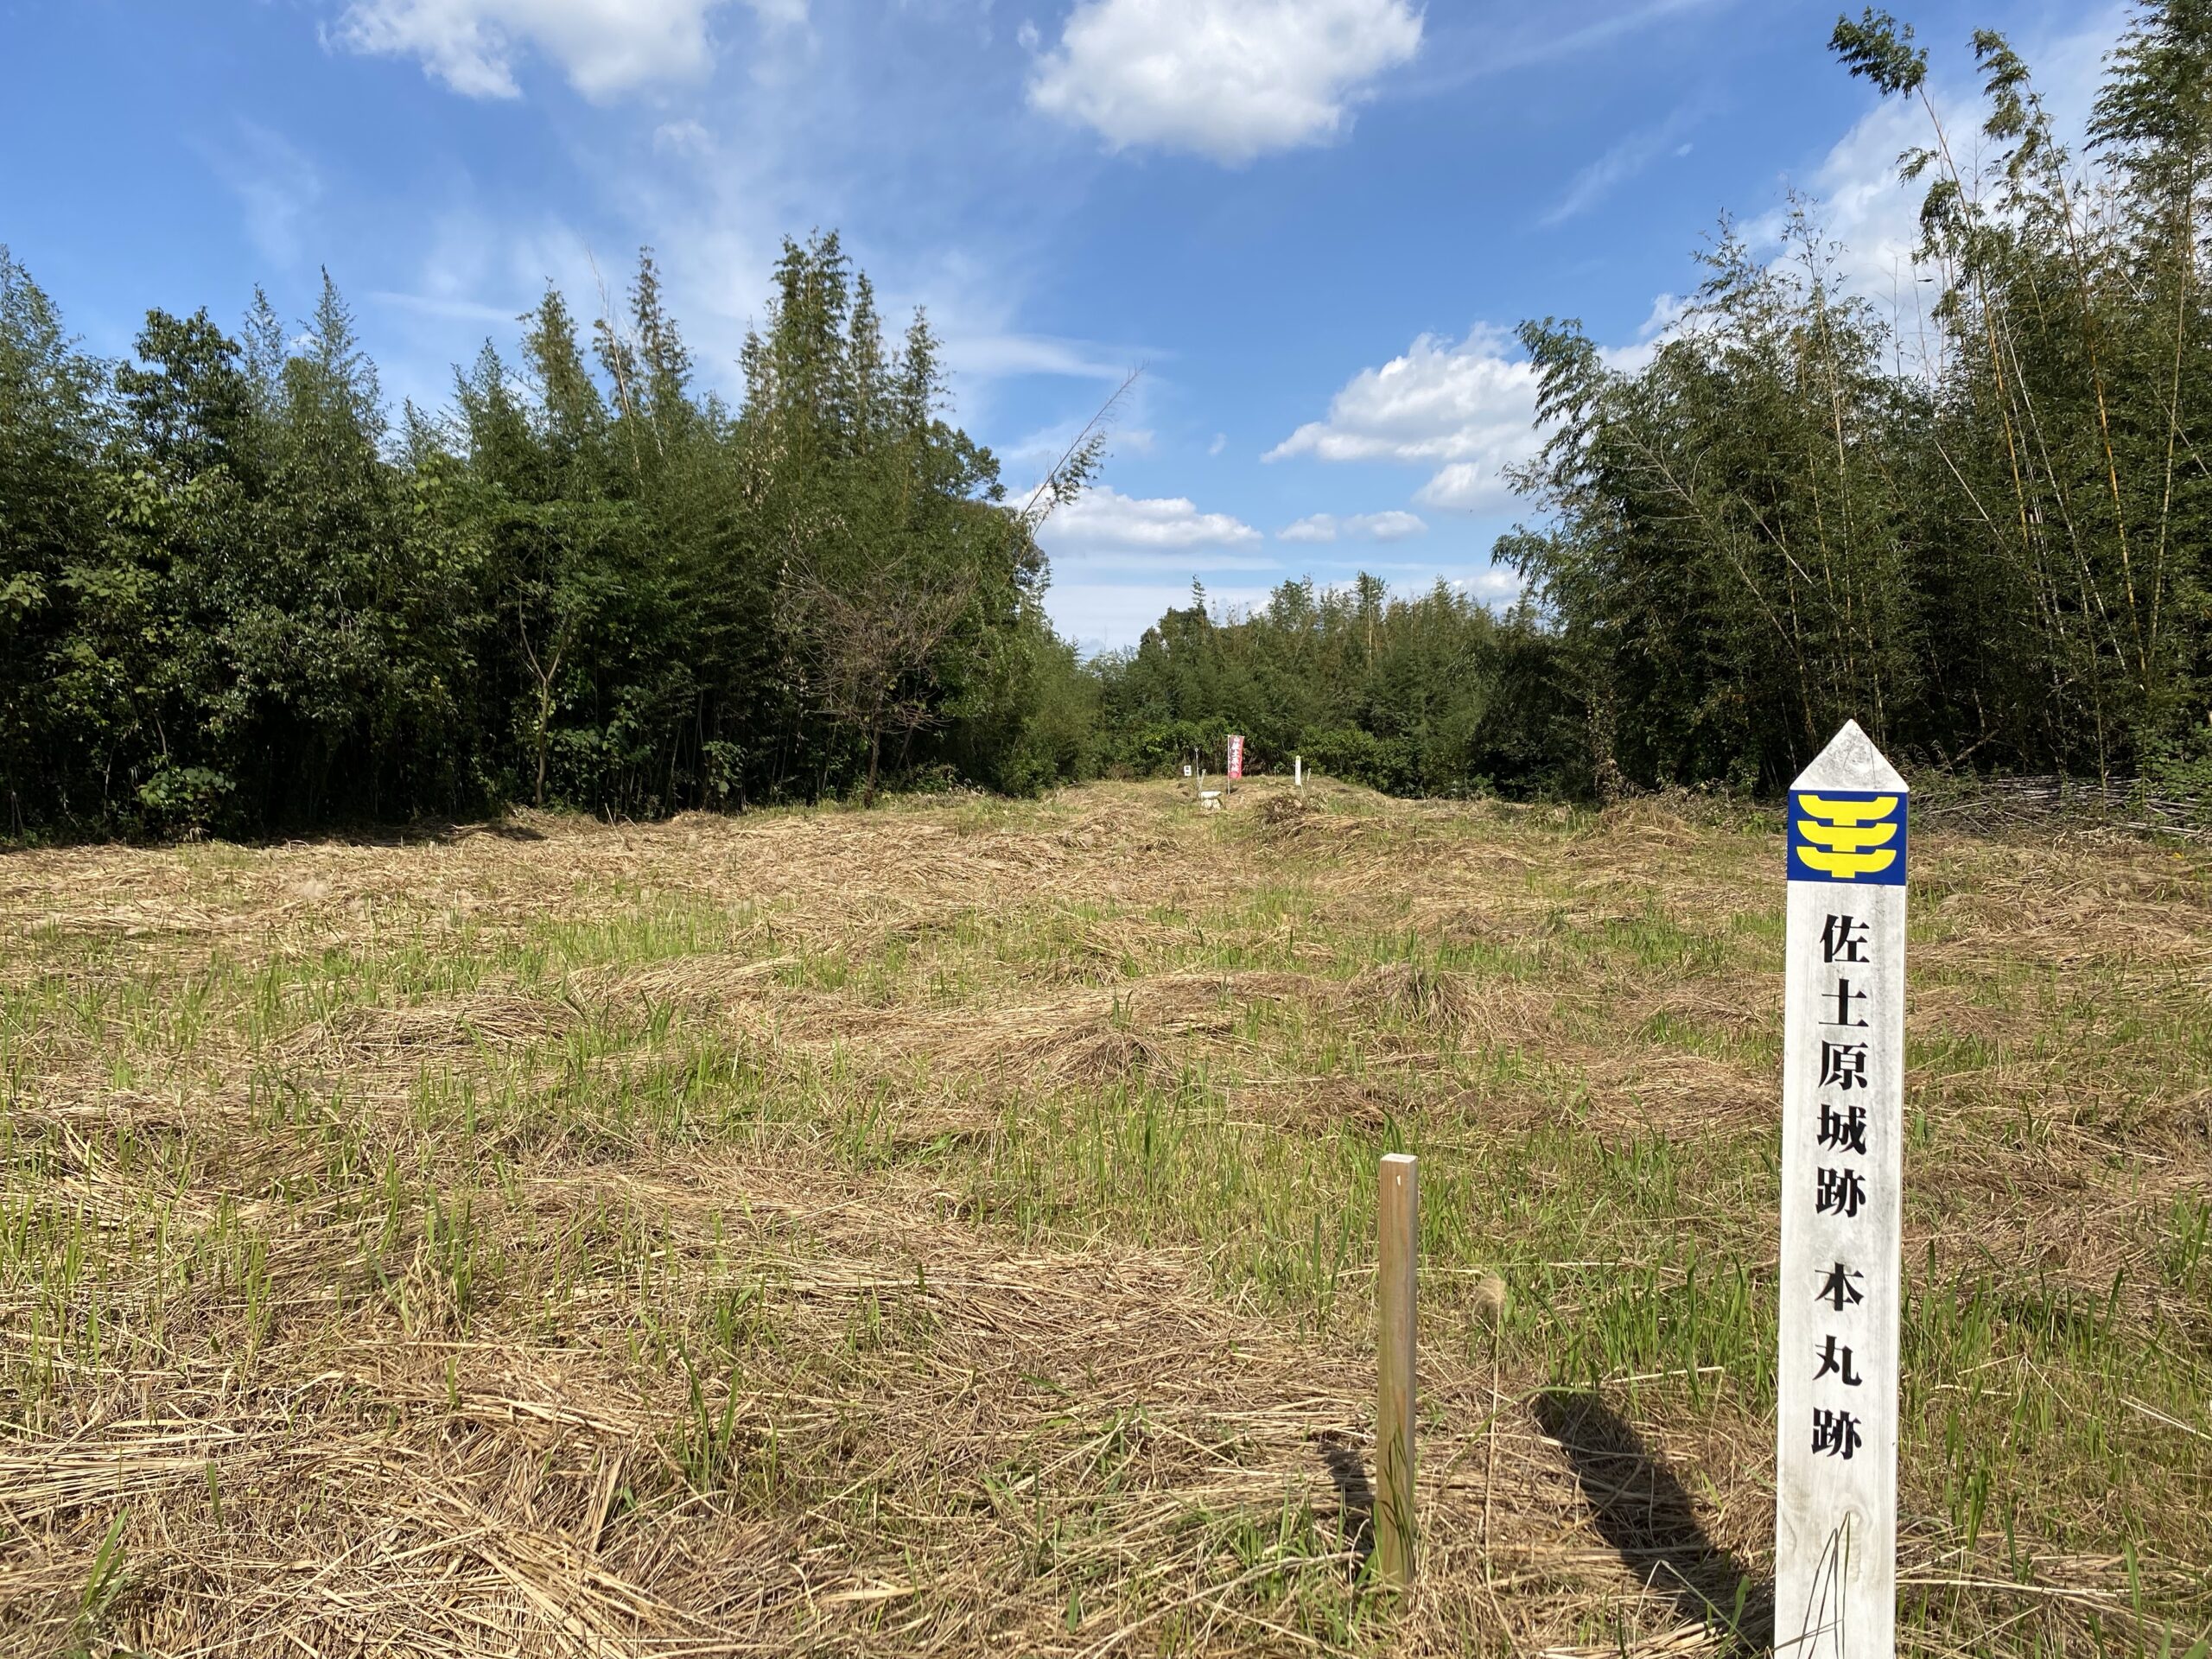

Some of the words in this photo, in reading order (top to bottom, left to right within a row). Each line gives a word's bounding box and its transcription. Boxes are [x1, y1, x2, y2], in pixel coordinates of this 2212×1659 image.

[1815, 912, 1871, 1217] 佐土原城跡
[1811, 1261, 1865, 1460] 本丸跡
